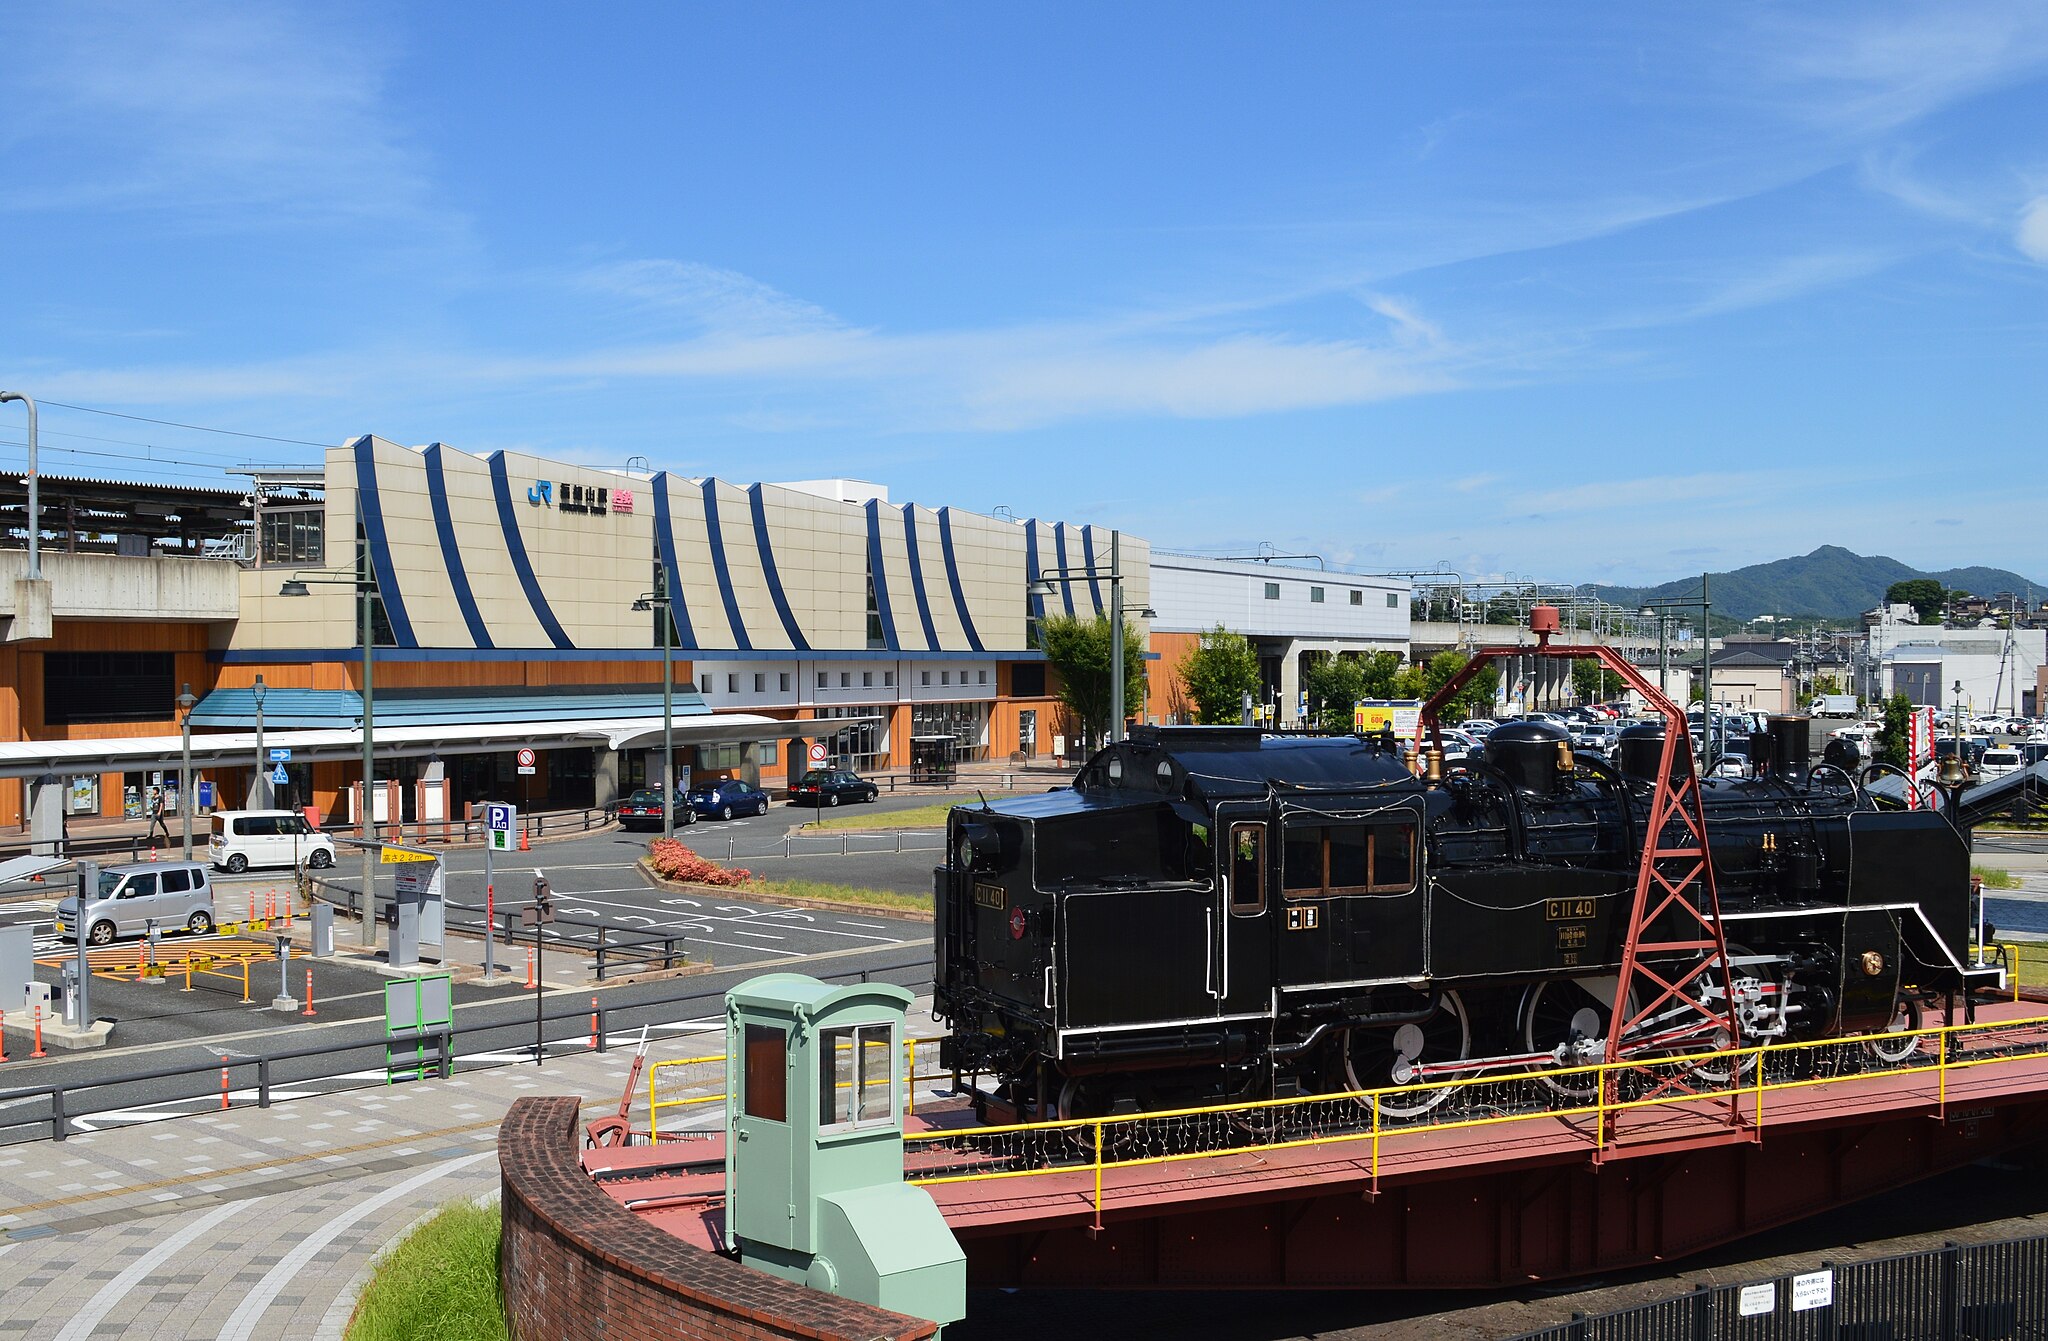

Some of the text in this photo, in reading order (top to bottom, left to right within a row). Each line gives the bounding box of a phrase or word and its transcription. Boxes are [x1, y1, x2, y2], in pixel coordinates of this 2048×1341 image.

[527, 480, 552, 504] JR
[492, 808, 504, 828] P
[497, 821, 507, 829] 入口
[382, 853, 422, 863] 高さ2.2m
[1575, 901, 1592, 916] 40
